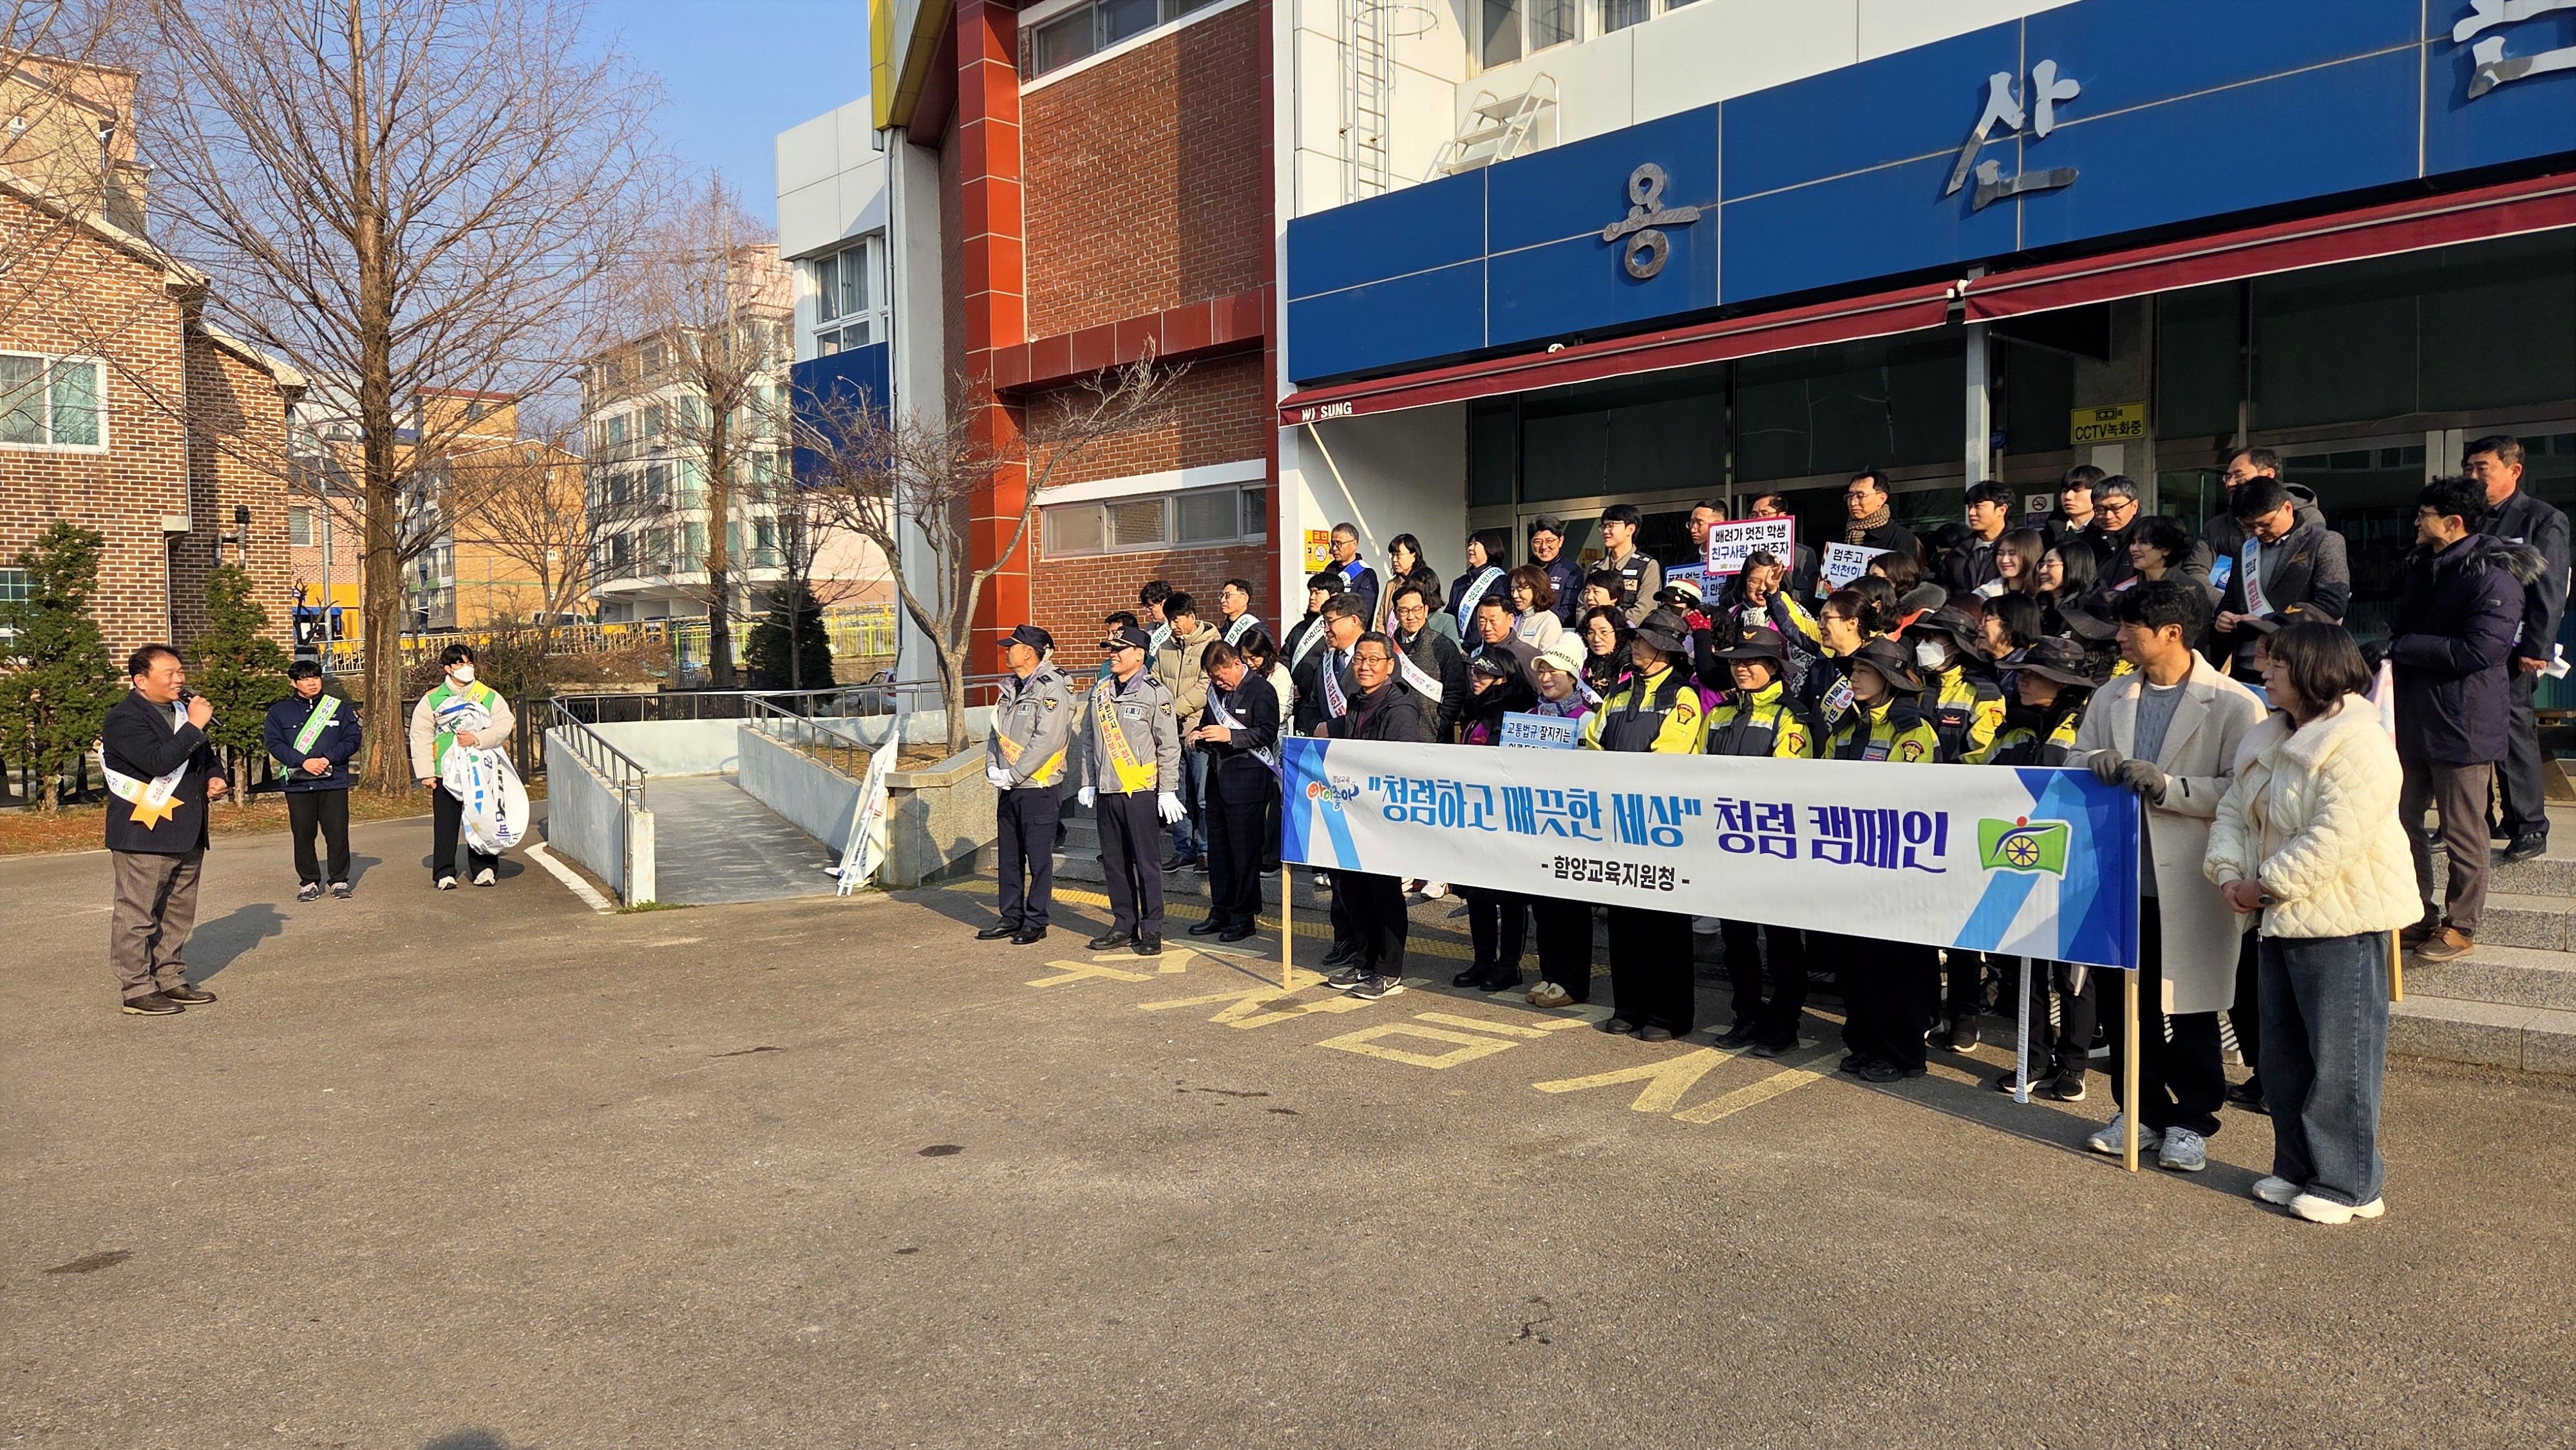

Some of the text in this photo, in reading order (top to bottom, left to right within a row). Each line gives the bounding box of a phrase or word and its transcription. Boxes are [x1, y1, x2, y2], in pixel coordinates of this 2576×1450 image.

[1320, 401, 1352, 419] SUNG
[2075, 420, 2142, 440] CCTV녹화중
[1314, 531, 1328, 540] 금연
[1716, 523, 1786, 543] 배려가 멋진 학생
[1711, 544, 1749, 560] 친구사랑
[1833, 548, 1864, 564] 멈추고
[1830, 563, 1861, 579] 천천히
[1824, 676, 1850, 707] 스쿨존
[1837, 697, 1847, 707] STOP
[1104, 704, 1117, 730] 반드시
[1113, 733, 1134, 767] 일시정지
[1507, 722, 1571, 743] 교통법규 잘지키는
[1332, 775, 1350, 784] 경남교육
[1307, 782, 1360, 810] 아이좋아
[1368, 774, 1949, 874] "청렴하고 깨끗한 세상" 청렴 캠페인
[1553, 855, 1676, 892] 함양교육지원청
